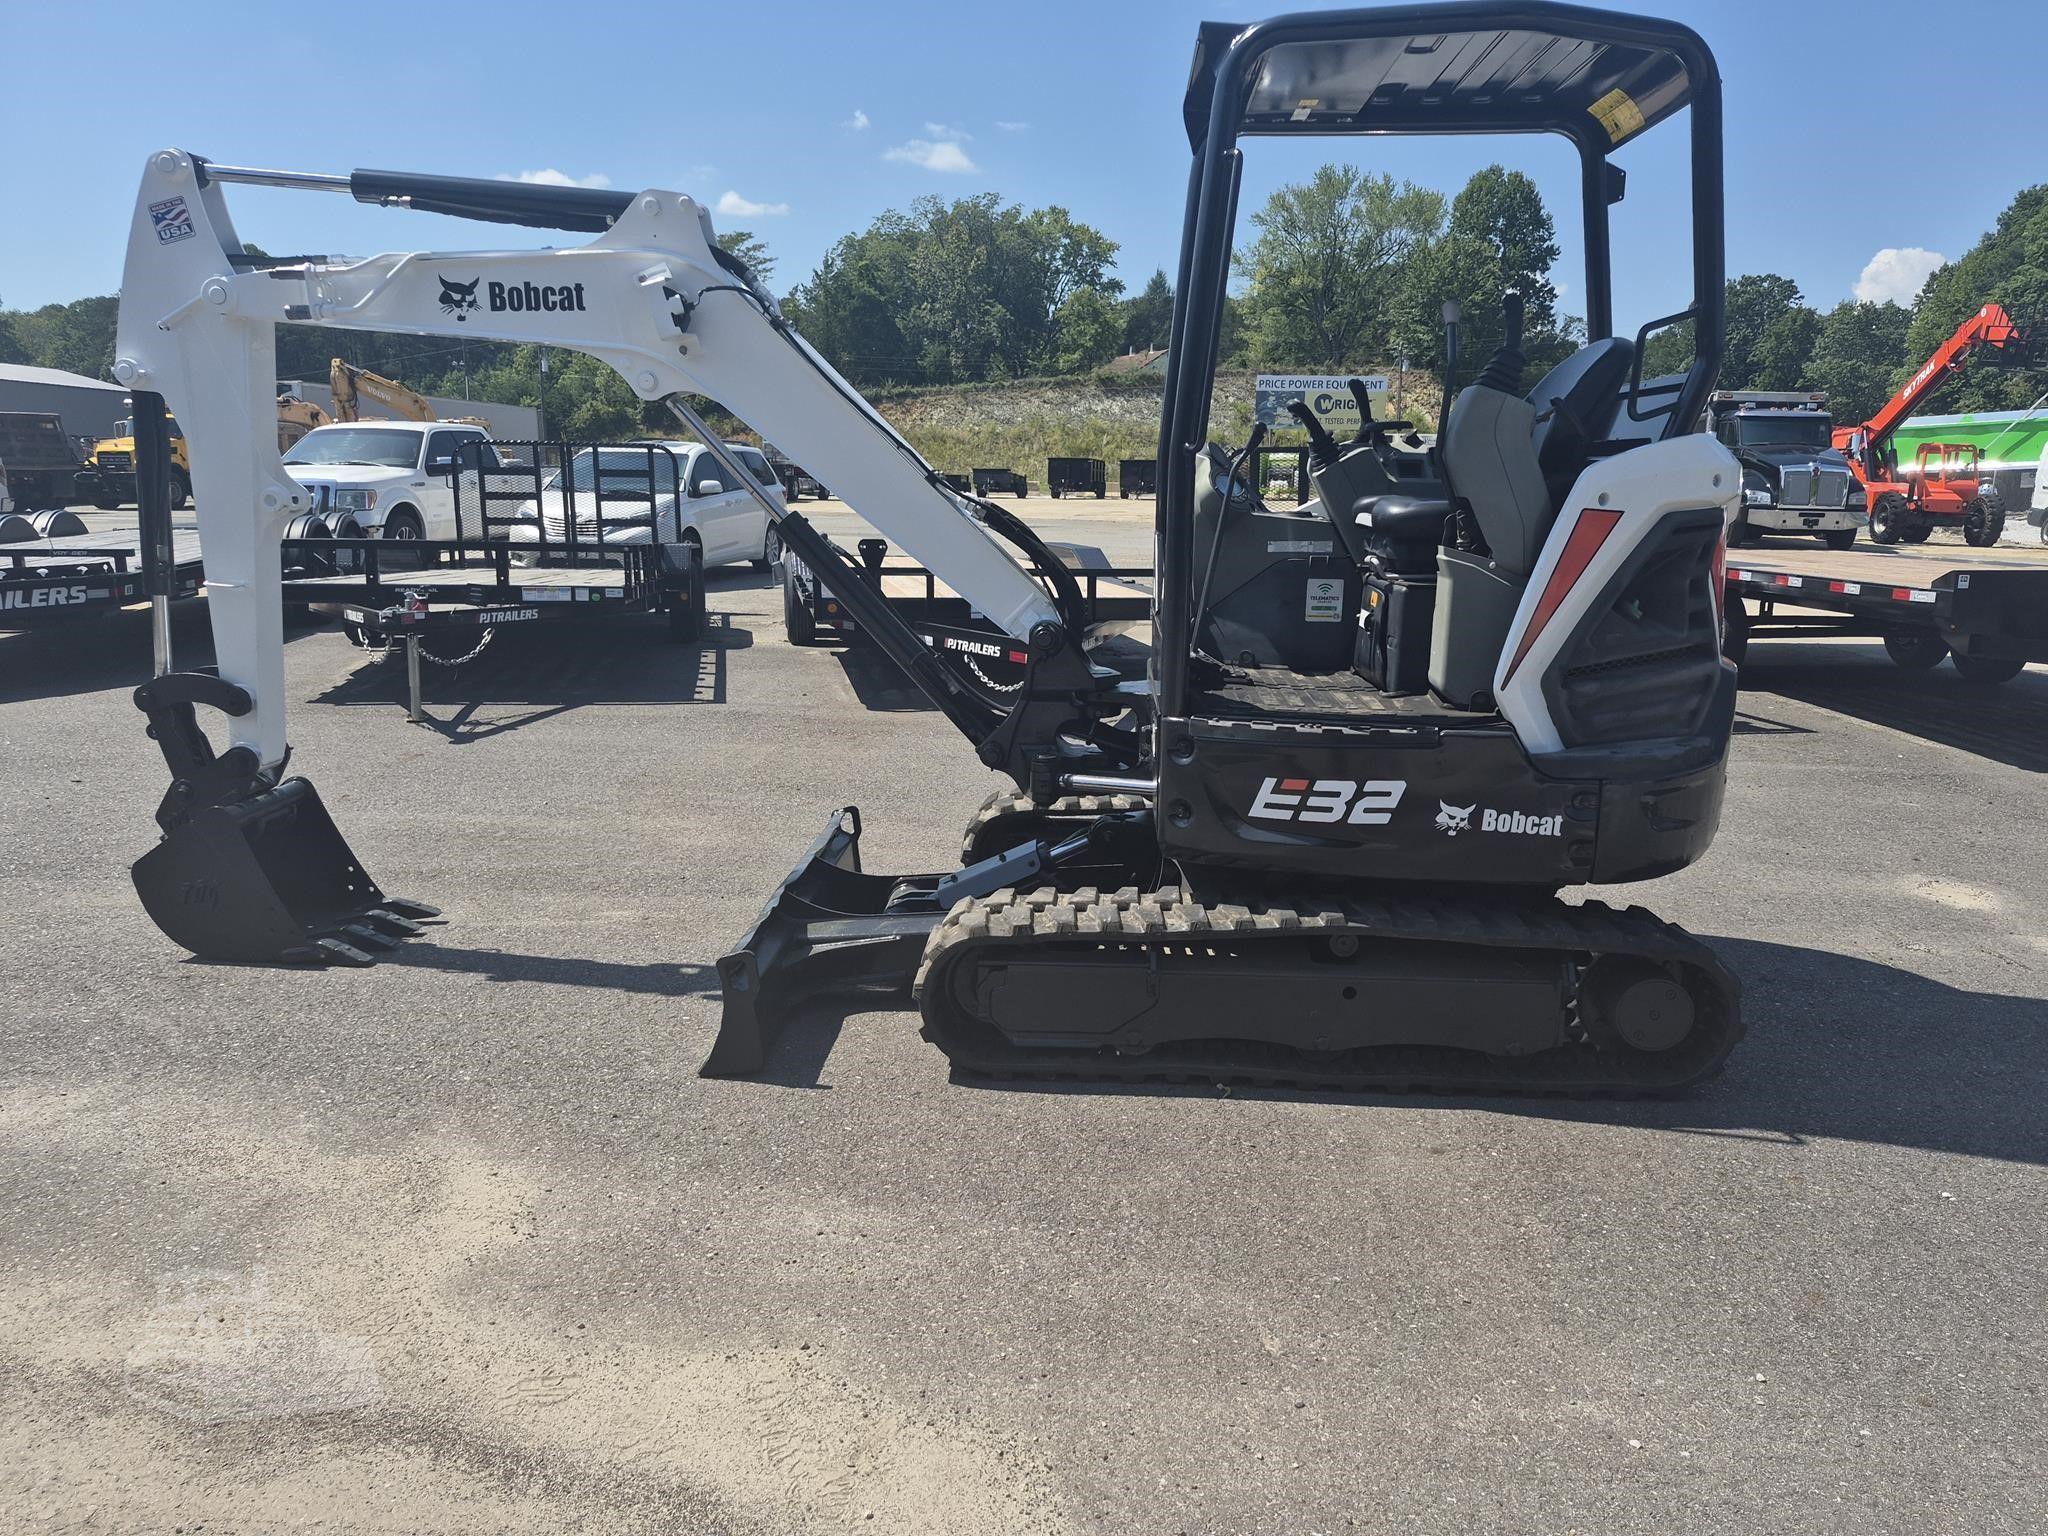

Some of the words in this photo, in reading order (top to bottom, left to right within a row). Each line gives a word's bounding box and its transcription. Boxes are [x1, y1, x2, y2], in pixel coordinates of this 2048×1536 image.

[160, 223, 191, 240] USA
[488, 281, 586, 312] Bobcat
[367, 385, 391, 401] VOLVO
[1258, 379, 1287, 389] PRICE
[1288, 379, 1324, 389] POWER
[1325, 379, 1384, 390] EQUIENT
[1903, 359, 1936, 400] SKYTRAK
[0, 585, 87, 610] ILERS
[1248, 777, 1407, 825] E32
[1481, 808, 1564, 837] Bobcat
